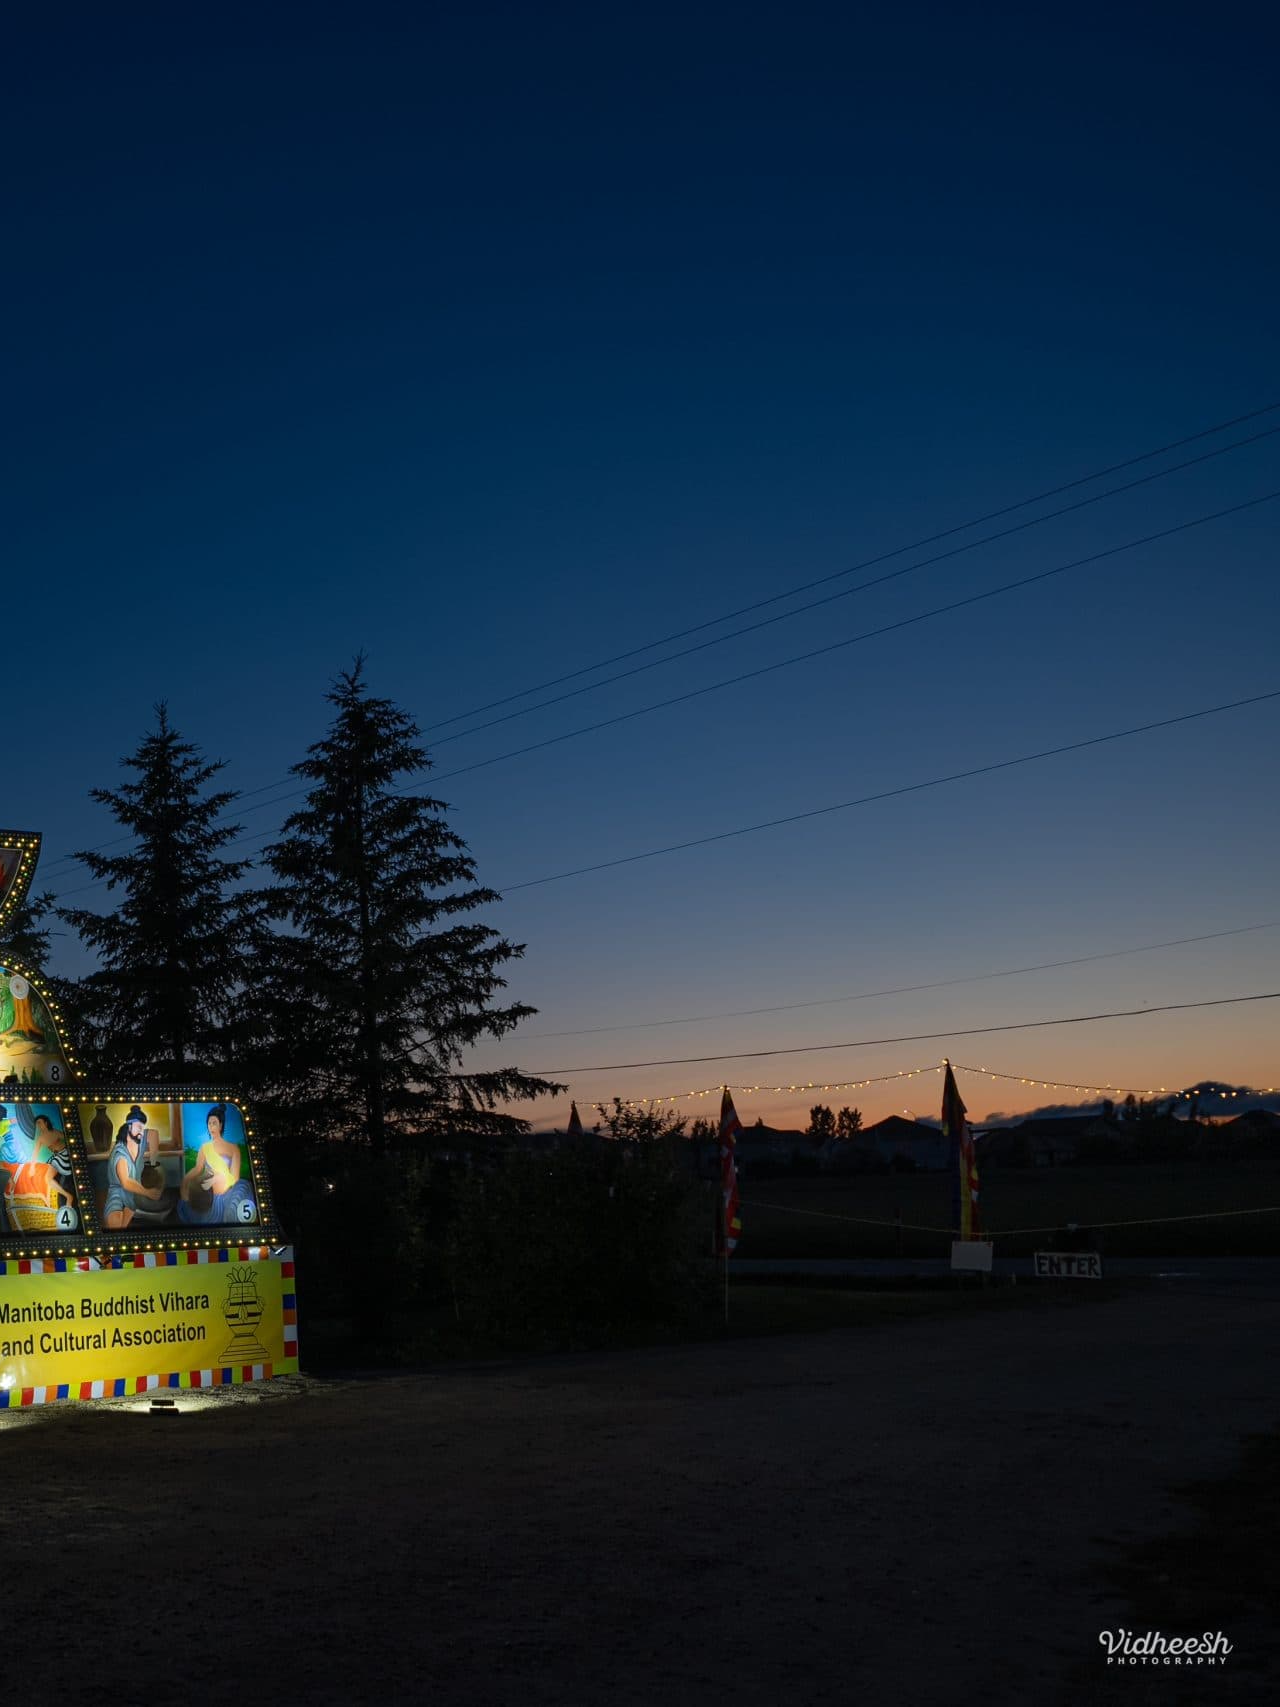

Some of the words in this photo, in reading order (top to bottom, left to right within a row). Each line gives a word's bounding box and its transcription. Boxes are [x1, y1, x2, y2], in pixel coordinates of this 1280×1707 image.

[50, 1065, 60, 1081] 8
[60, 1211, 71, 1227] 4
[242, 1204, 251, 1221] 5
[1037, 1255, 1099, 1276] ENTER
[81, 1294, 155, 1317] Buddhist
[158, 1290, 210, 1312] Vihara
[1, 1334, 35, 1357] and
[39, 1328, 107, 1353] Cultural
[111, 1322, 206, 1347] Association
